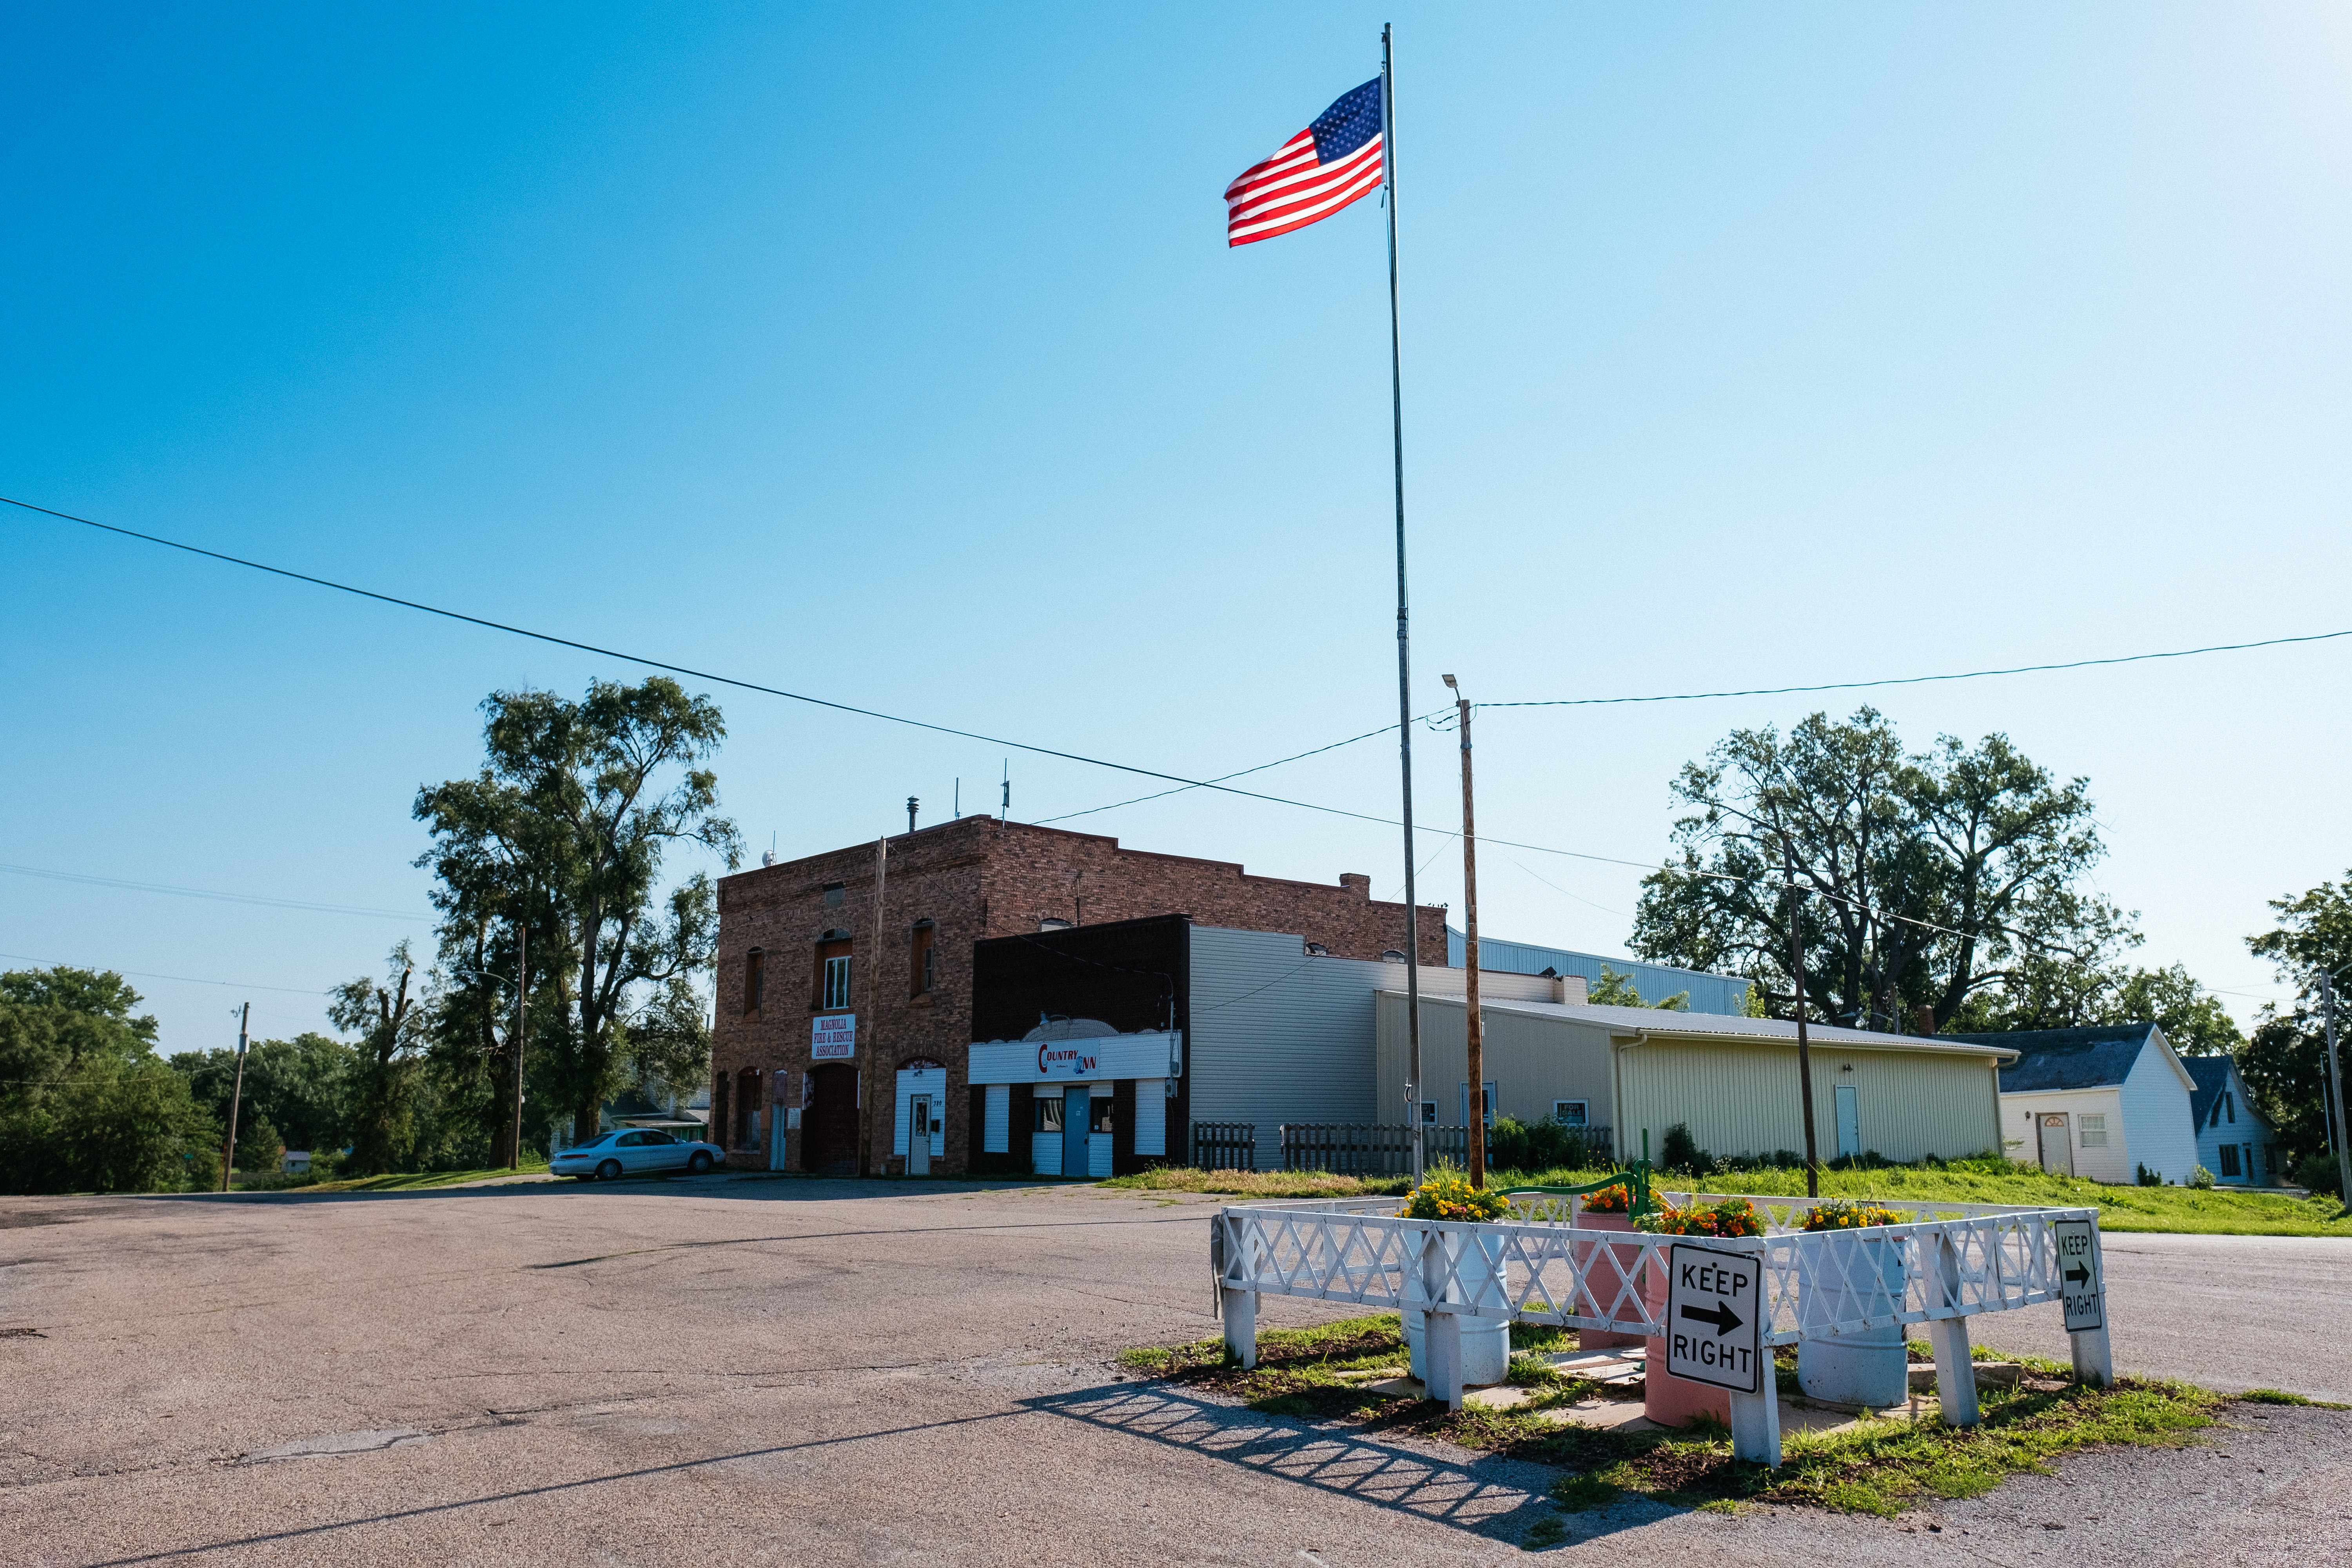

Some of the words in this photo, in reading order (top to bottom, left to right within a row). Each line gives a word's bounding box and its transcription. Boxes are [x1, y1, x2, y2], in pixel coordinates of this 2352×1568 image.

[820, 1018, 846, 1030] MAGNOLIA
[814, 1033, 826, 1044] FIRE
[828, 1033, 831, 1043] &
[833, 1031, 853, 1042] RESCUE
[816, 1044, 849, 1056] ASSOCIATION
[1038, 1044, 1078, 1073] COUNTRY
[2062, 1235, 2088, 1256] KEEP
[1682, 1263, 1748, 1297] KEEP
[2065, 1294, 2097, 1317] RIGHT
[1673, 1334, 1752, 1373] RIGHT
